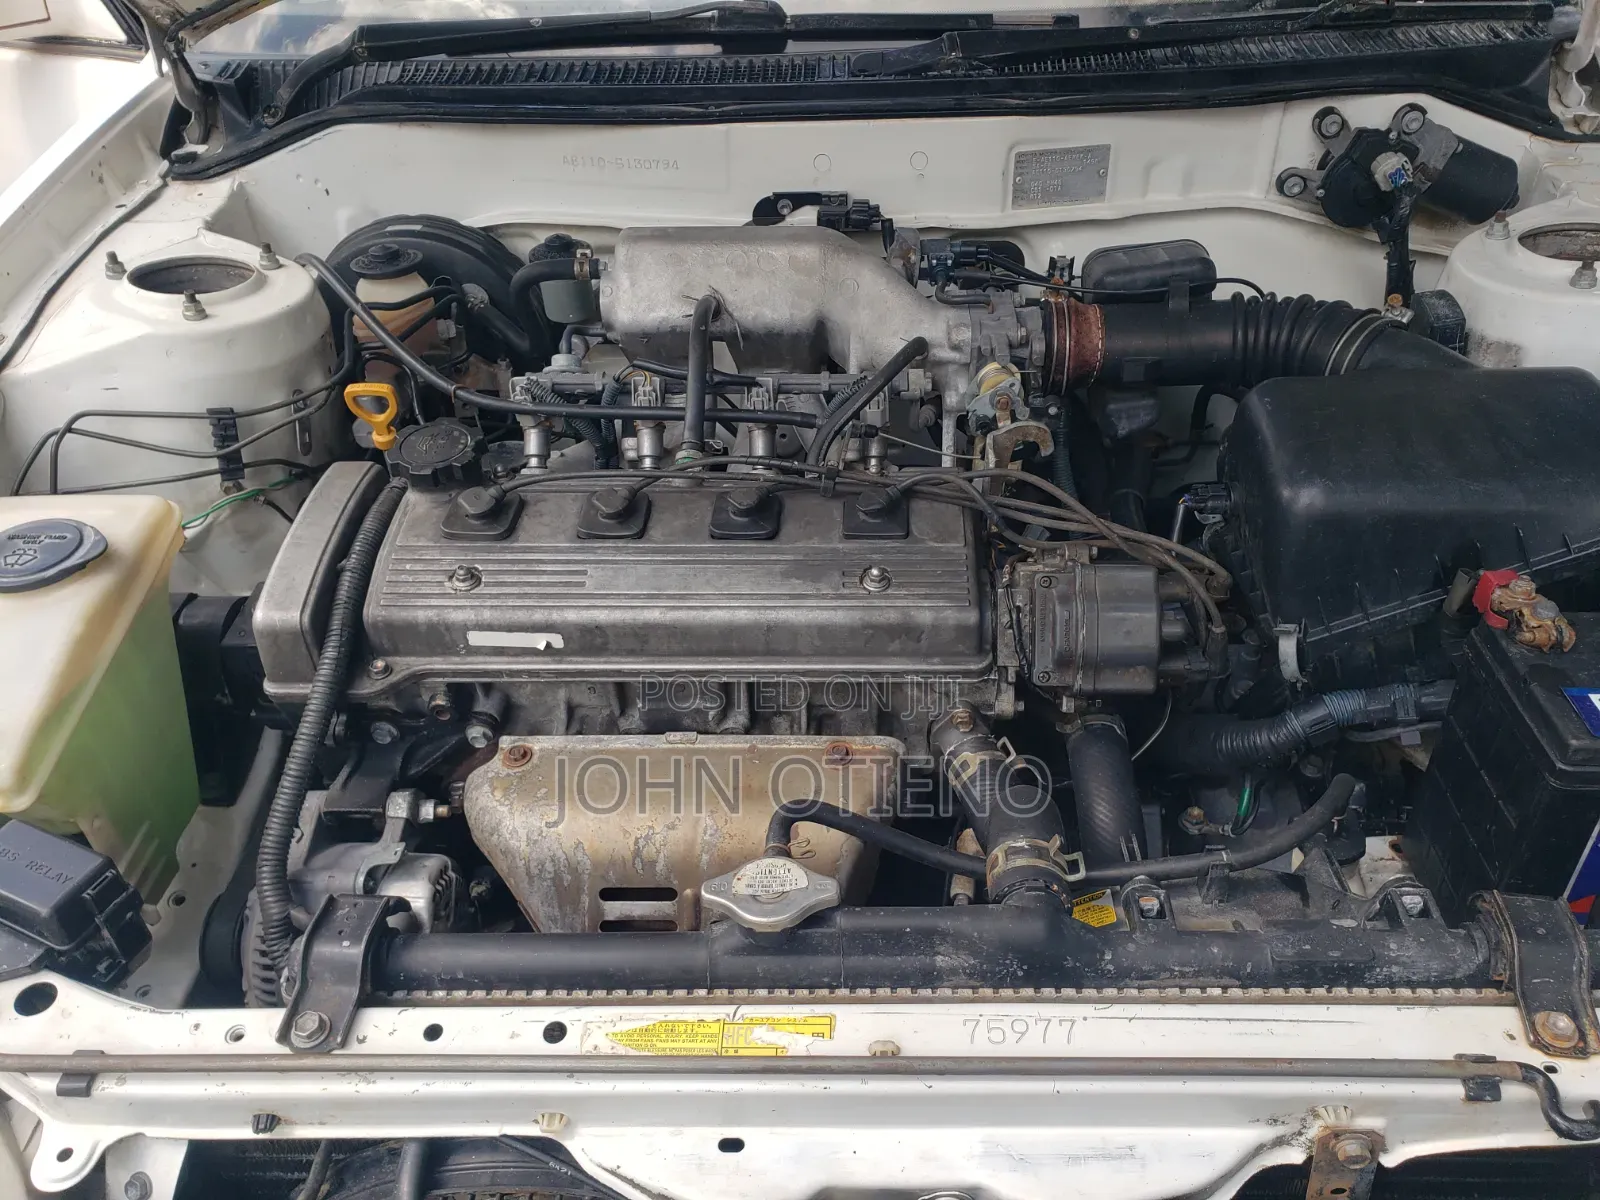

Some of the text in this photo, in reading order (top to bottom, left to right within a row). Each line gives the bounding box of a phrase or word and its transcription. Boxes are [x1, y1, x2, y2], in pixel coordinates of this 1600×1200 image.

[0, 843, 74, 885] BS RELAY
[963, 1018, 1077, 1045] 75977
